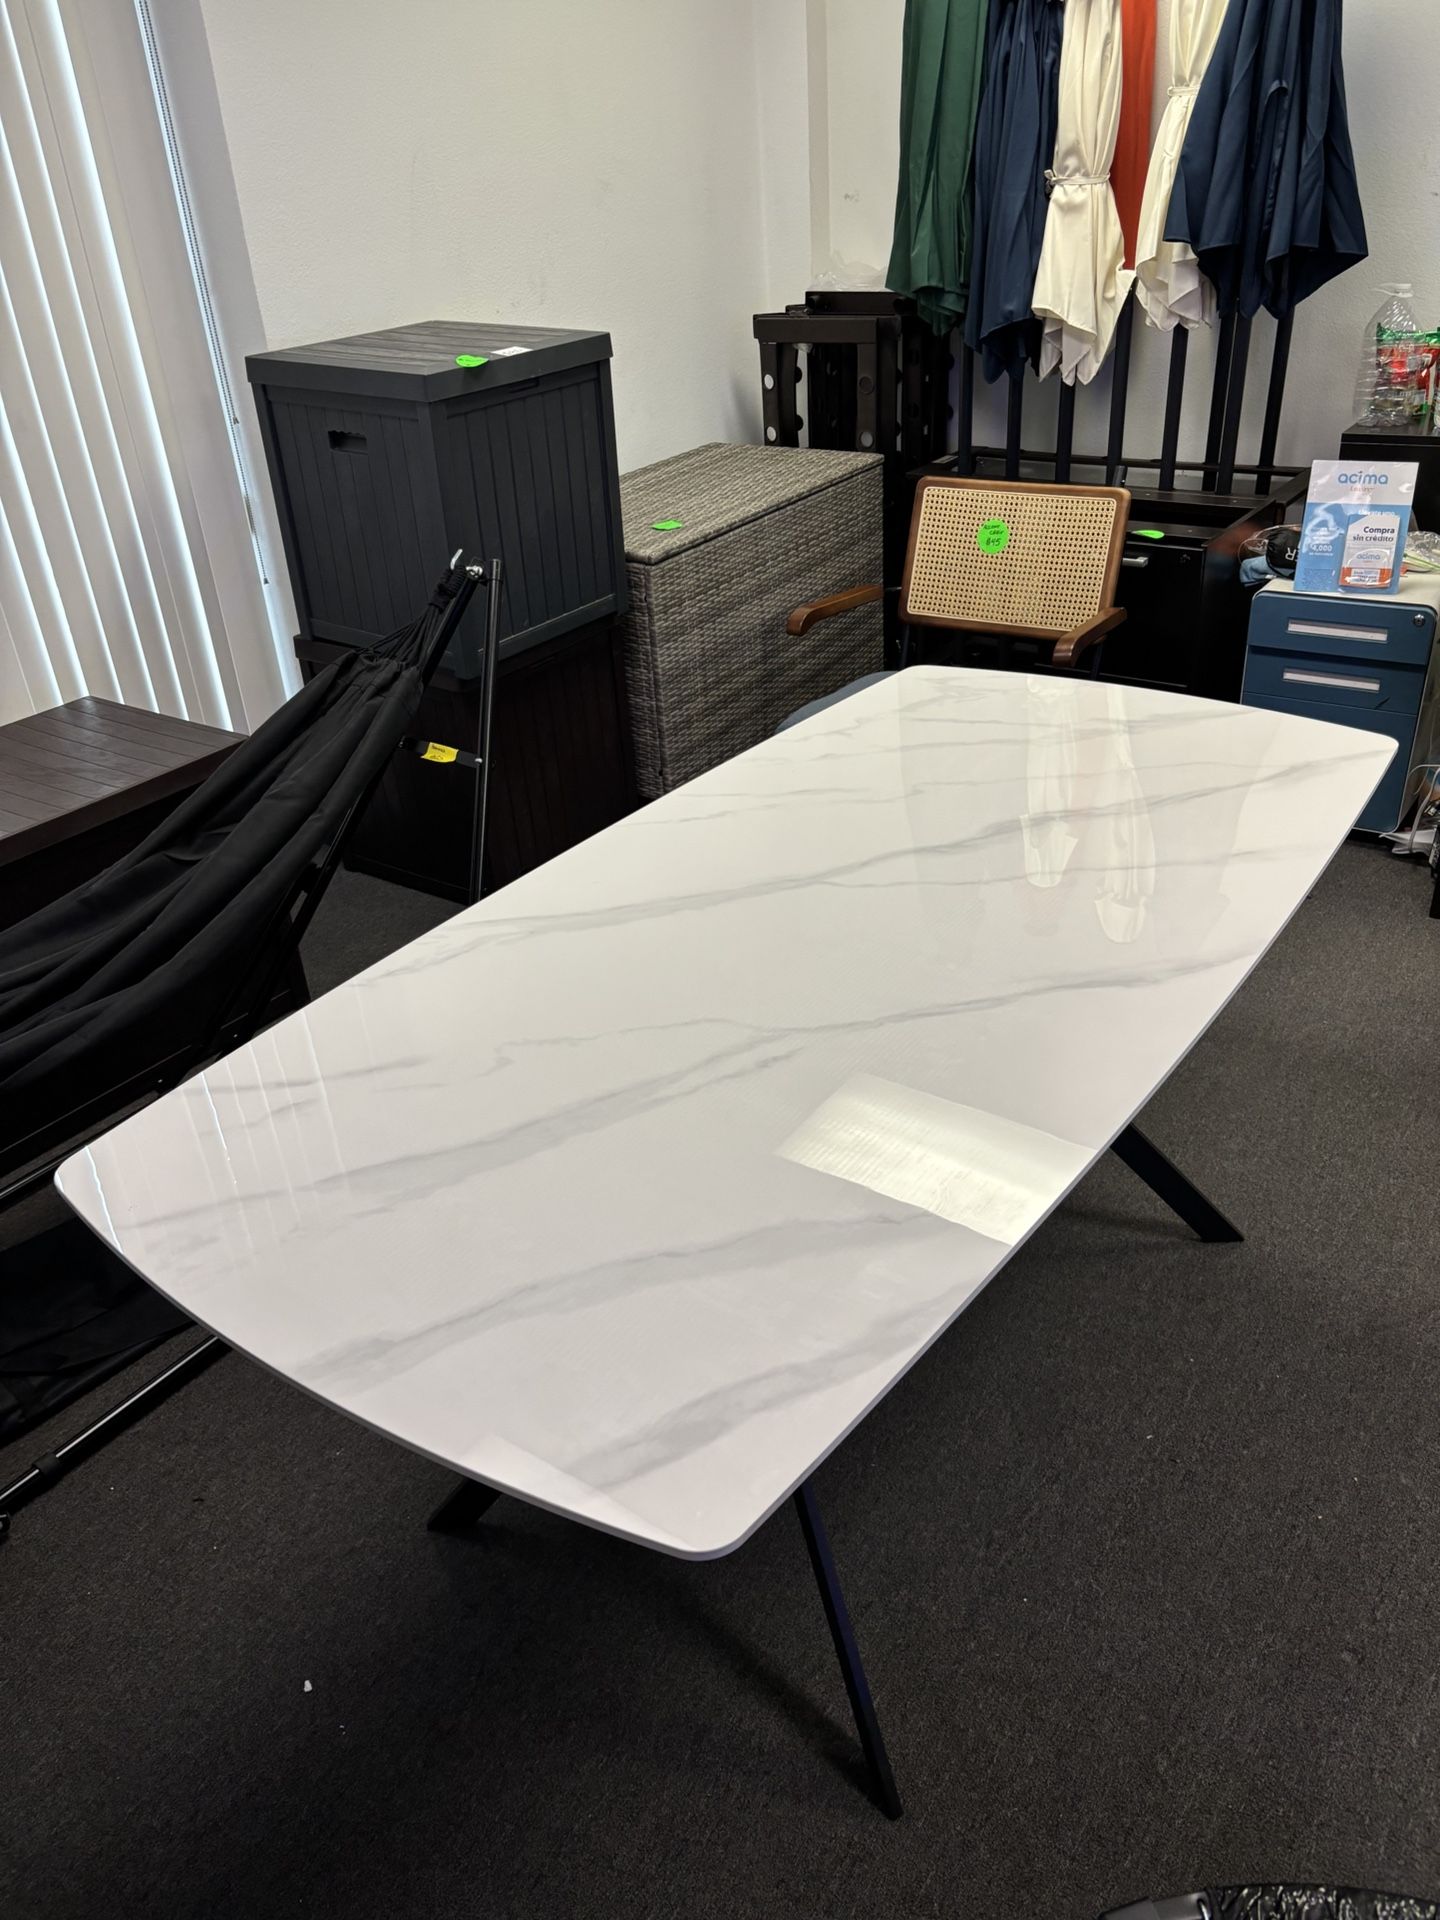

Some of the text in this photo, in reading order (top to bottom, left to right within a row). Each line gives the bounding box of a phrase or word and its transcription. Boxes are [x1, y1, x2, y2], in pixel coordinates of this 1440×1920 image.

[1338, 470, 1389, 485] acima
[1363, 526, 1395, 535] Compra
[1353, 534, 1394, 542] sin crédito
